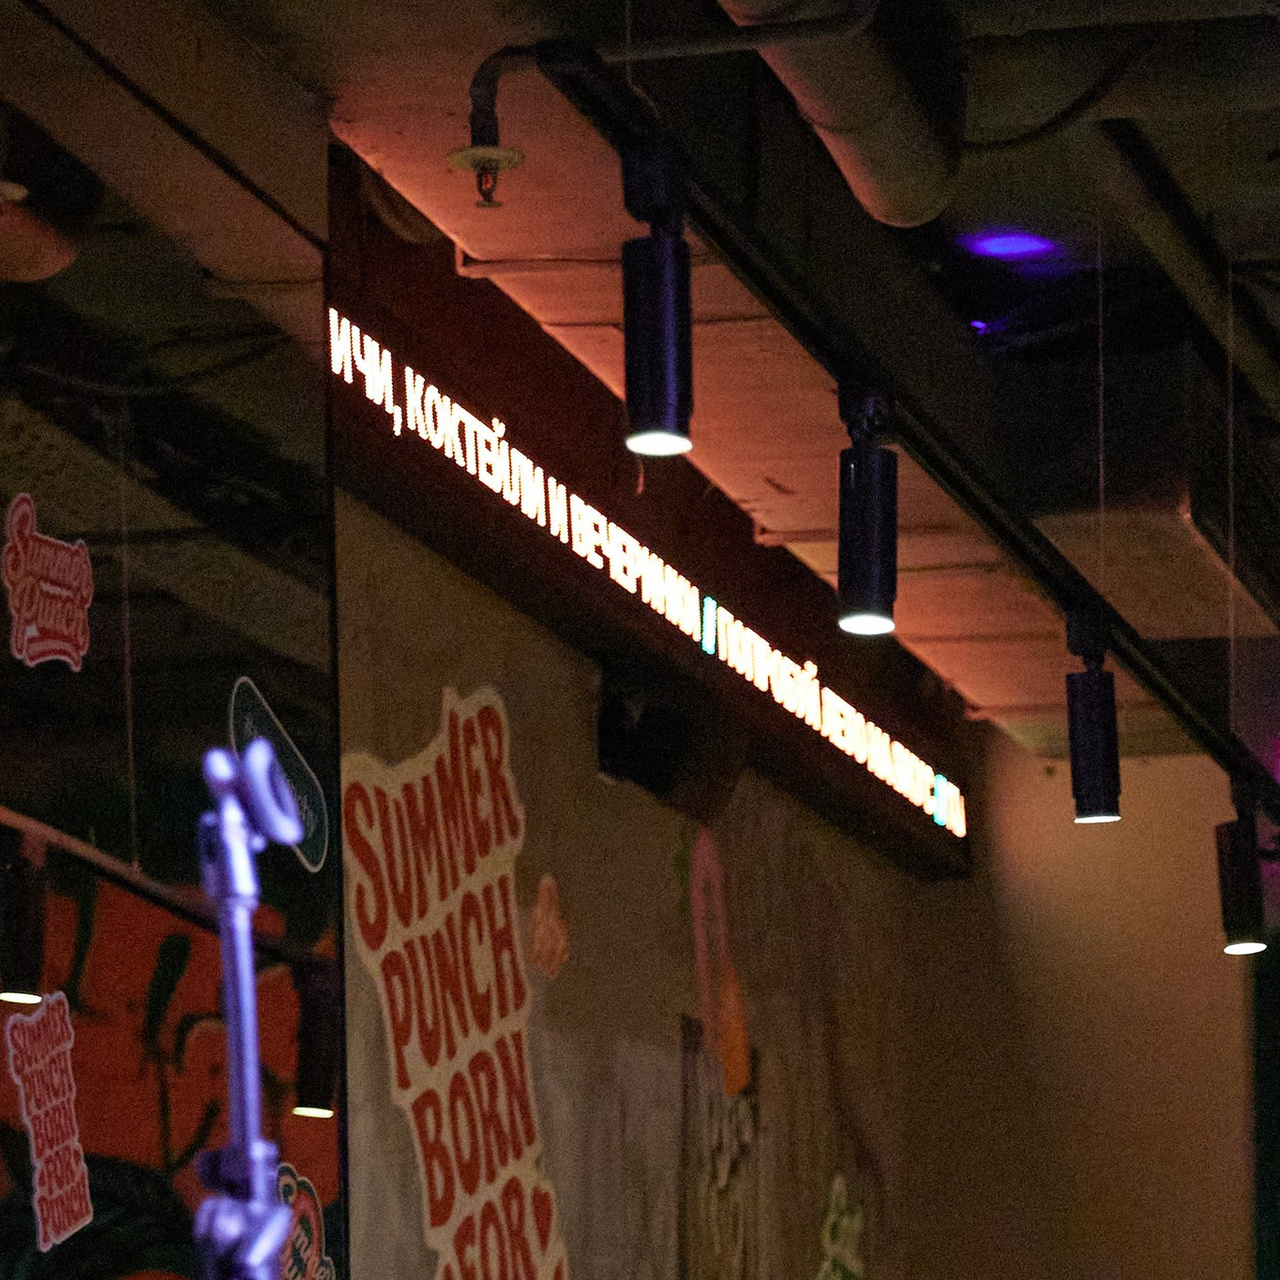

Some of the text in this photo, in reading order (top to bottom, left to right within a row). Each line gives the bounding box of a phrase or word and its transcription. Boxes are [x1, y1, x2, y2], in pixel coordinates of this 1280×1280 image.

[405, 366, 546, 527] КОКТЕЙЛИ
[548, 477, 569, 543] И
[570, 494, 702, 642] ВЕЧЕРИНКИ
[343, 703, 520, 951] SUMMER
[380, 874, 526, 1089] PUNCH
[410, 1030, 537, 1228] BORN
